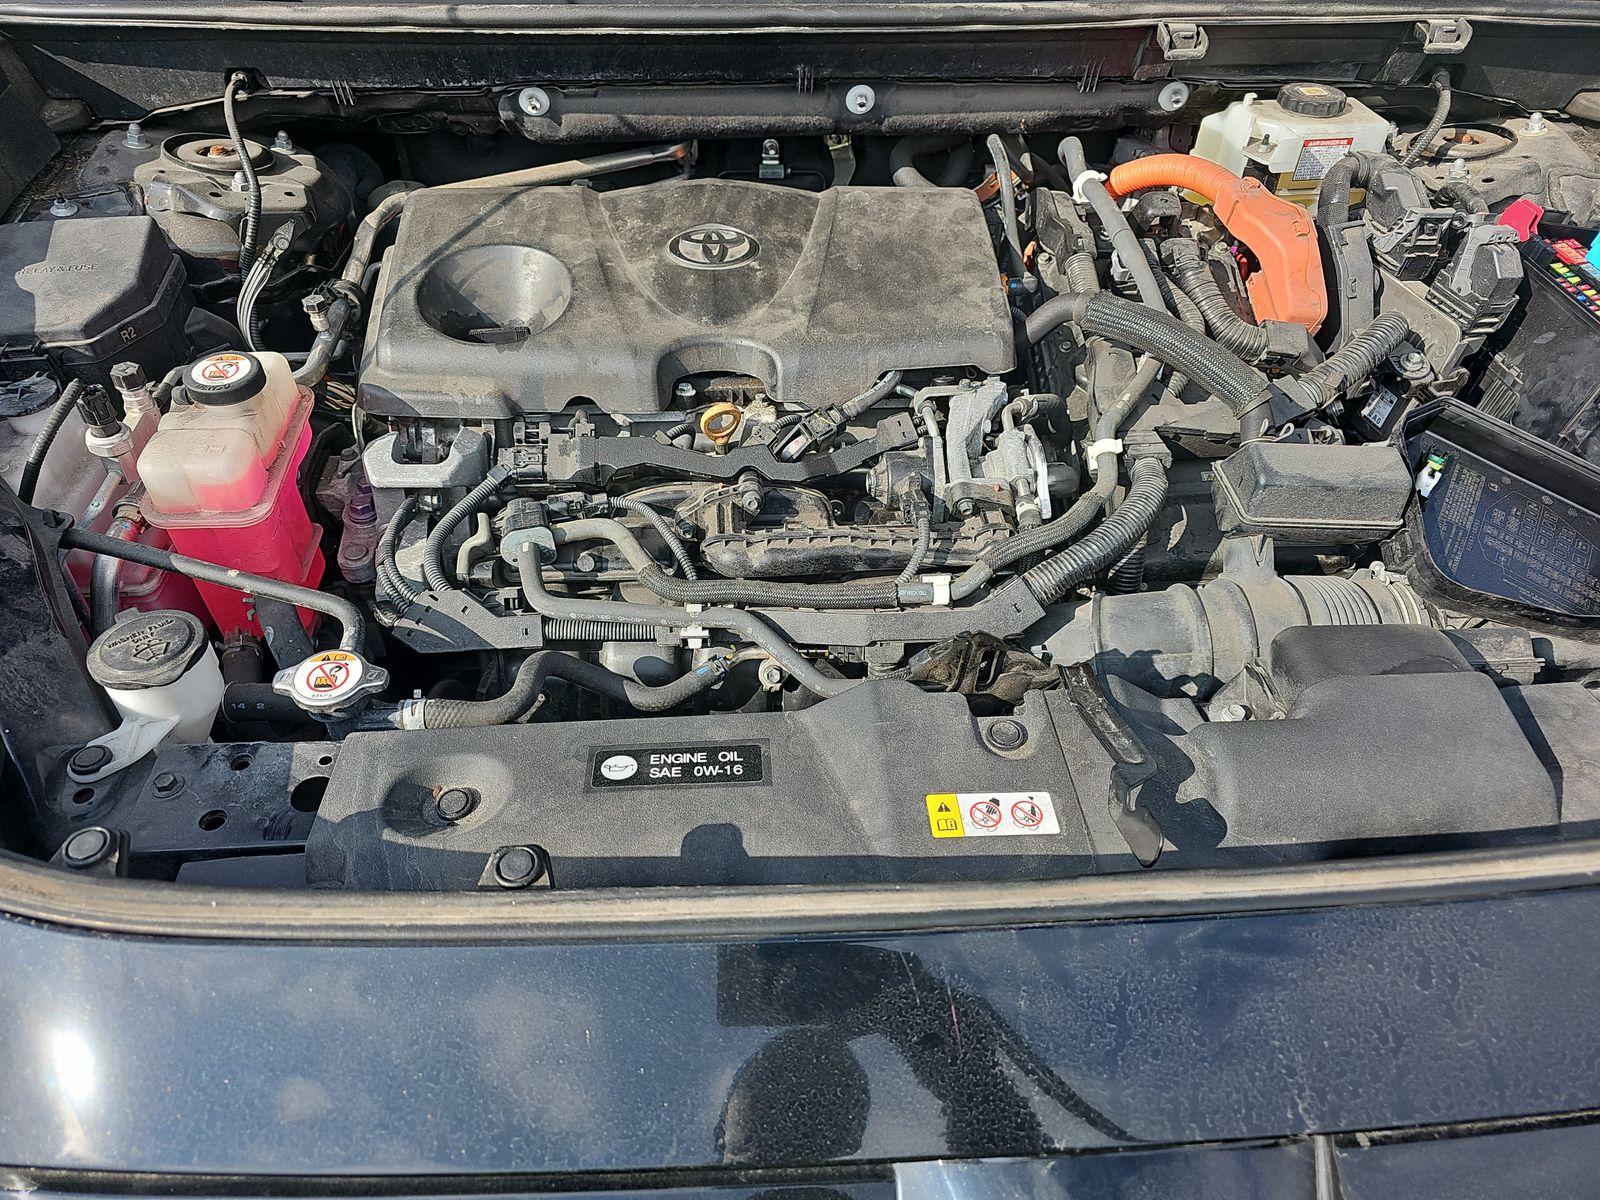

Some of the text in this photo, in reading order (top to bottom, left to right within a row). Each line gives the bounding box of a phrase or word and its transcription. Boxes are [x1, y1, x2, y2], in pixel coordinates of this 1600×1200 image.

[120, 326, 137, 342] R2
[650, 751, 744, 765] ENGINE OIL
[649, 765, 744, 778] SAE 0W-16
